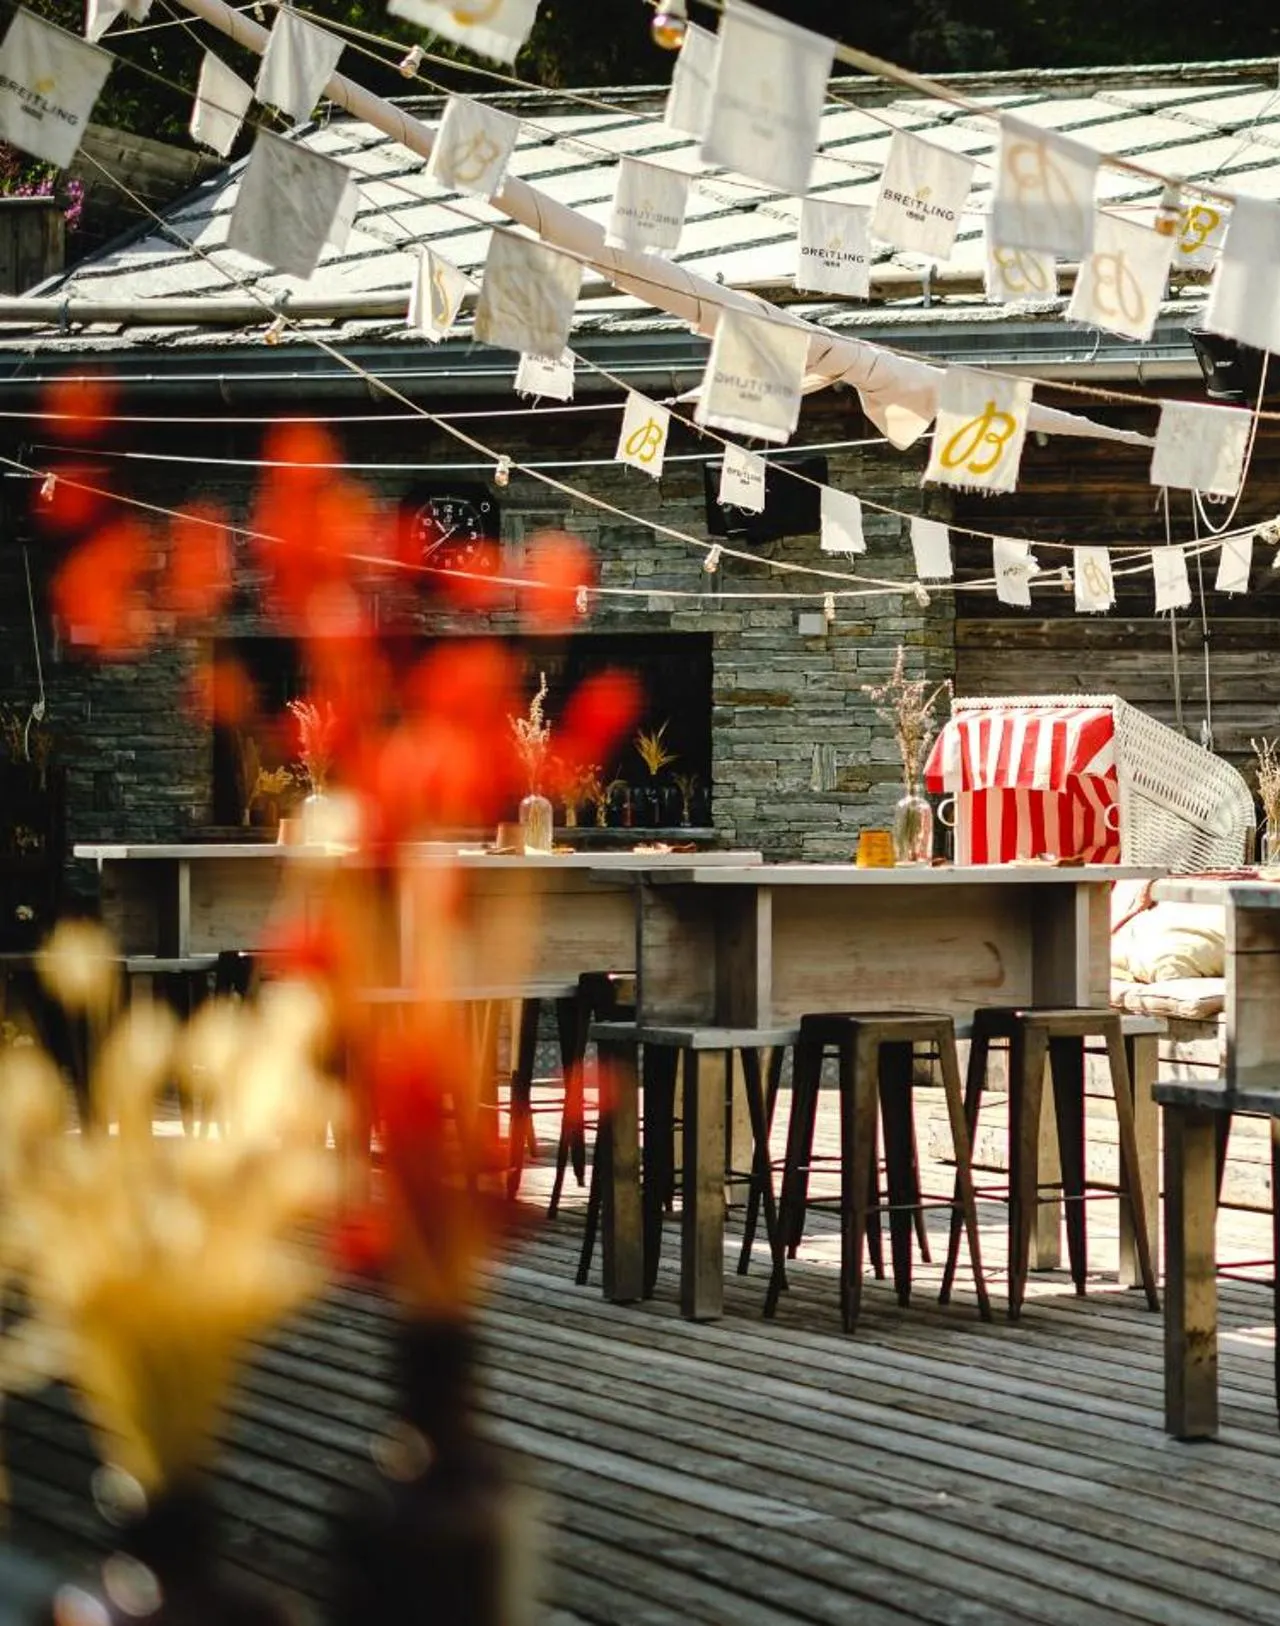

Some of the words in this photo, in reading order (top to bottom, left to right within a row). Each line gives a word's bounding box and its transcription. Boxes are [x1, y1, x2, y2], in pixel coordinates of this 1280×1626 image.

[883, 189, 955, 221] BREITLING
[801, 247, 864, 263] BREITLING
[626, 417, 663, 462] B
[940, 400, 1017, 474] B
